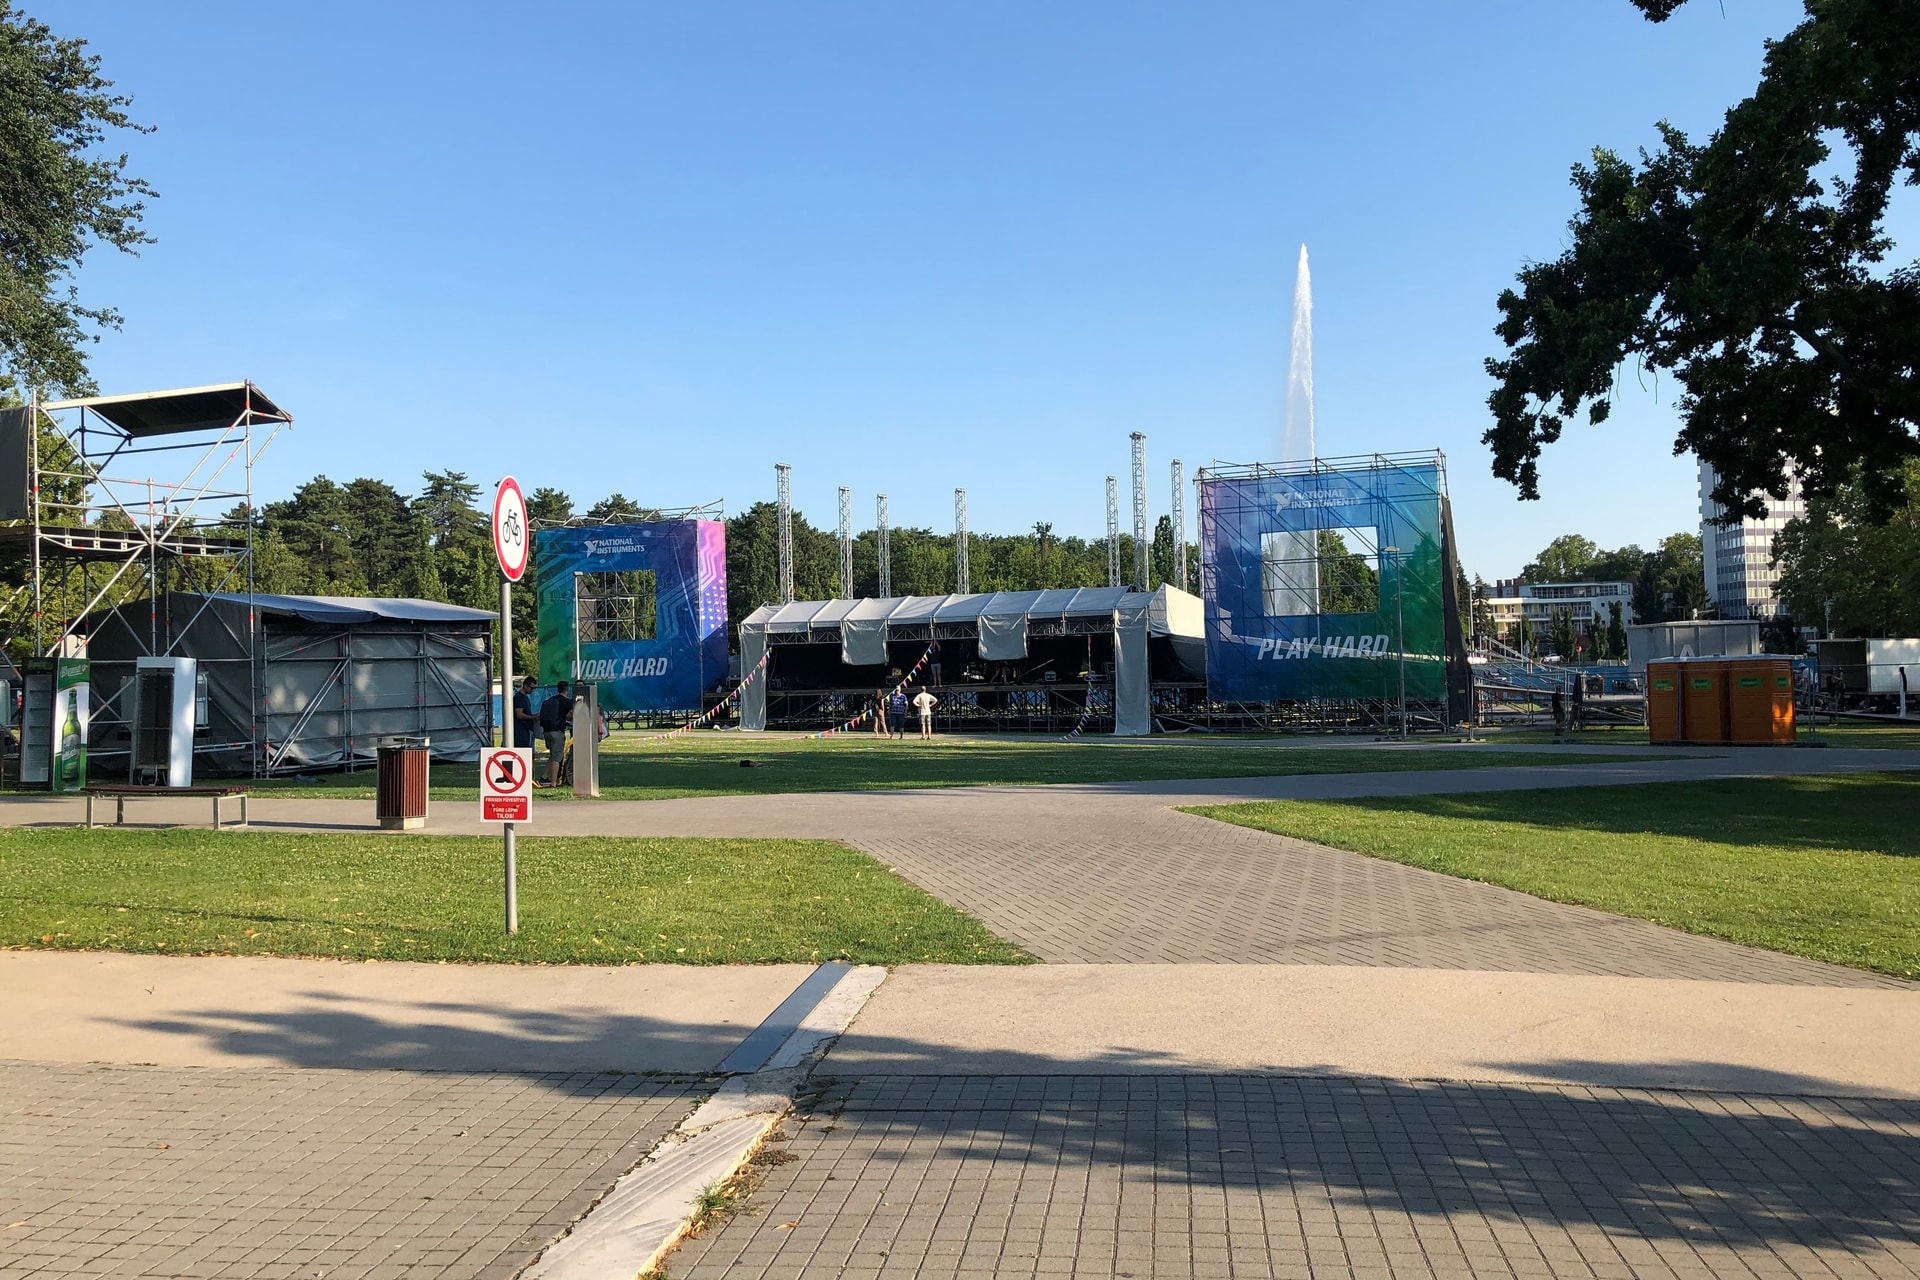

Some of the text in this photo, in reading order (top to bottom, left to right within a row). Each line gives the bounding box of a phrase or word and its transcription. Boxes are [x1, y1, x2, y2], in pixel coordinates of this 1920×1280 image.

[1294, 489, 1344, 501] NATIONAL
[599, 538, 634, 547] NATIONAL
[597, 545, 645, 554] INSTRUMENTS
[1257, 634, 1389, 661] PLAY HARD
[570, 657, 668, 678] WORK HARD
